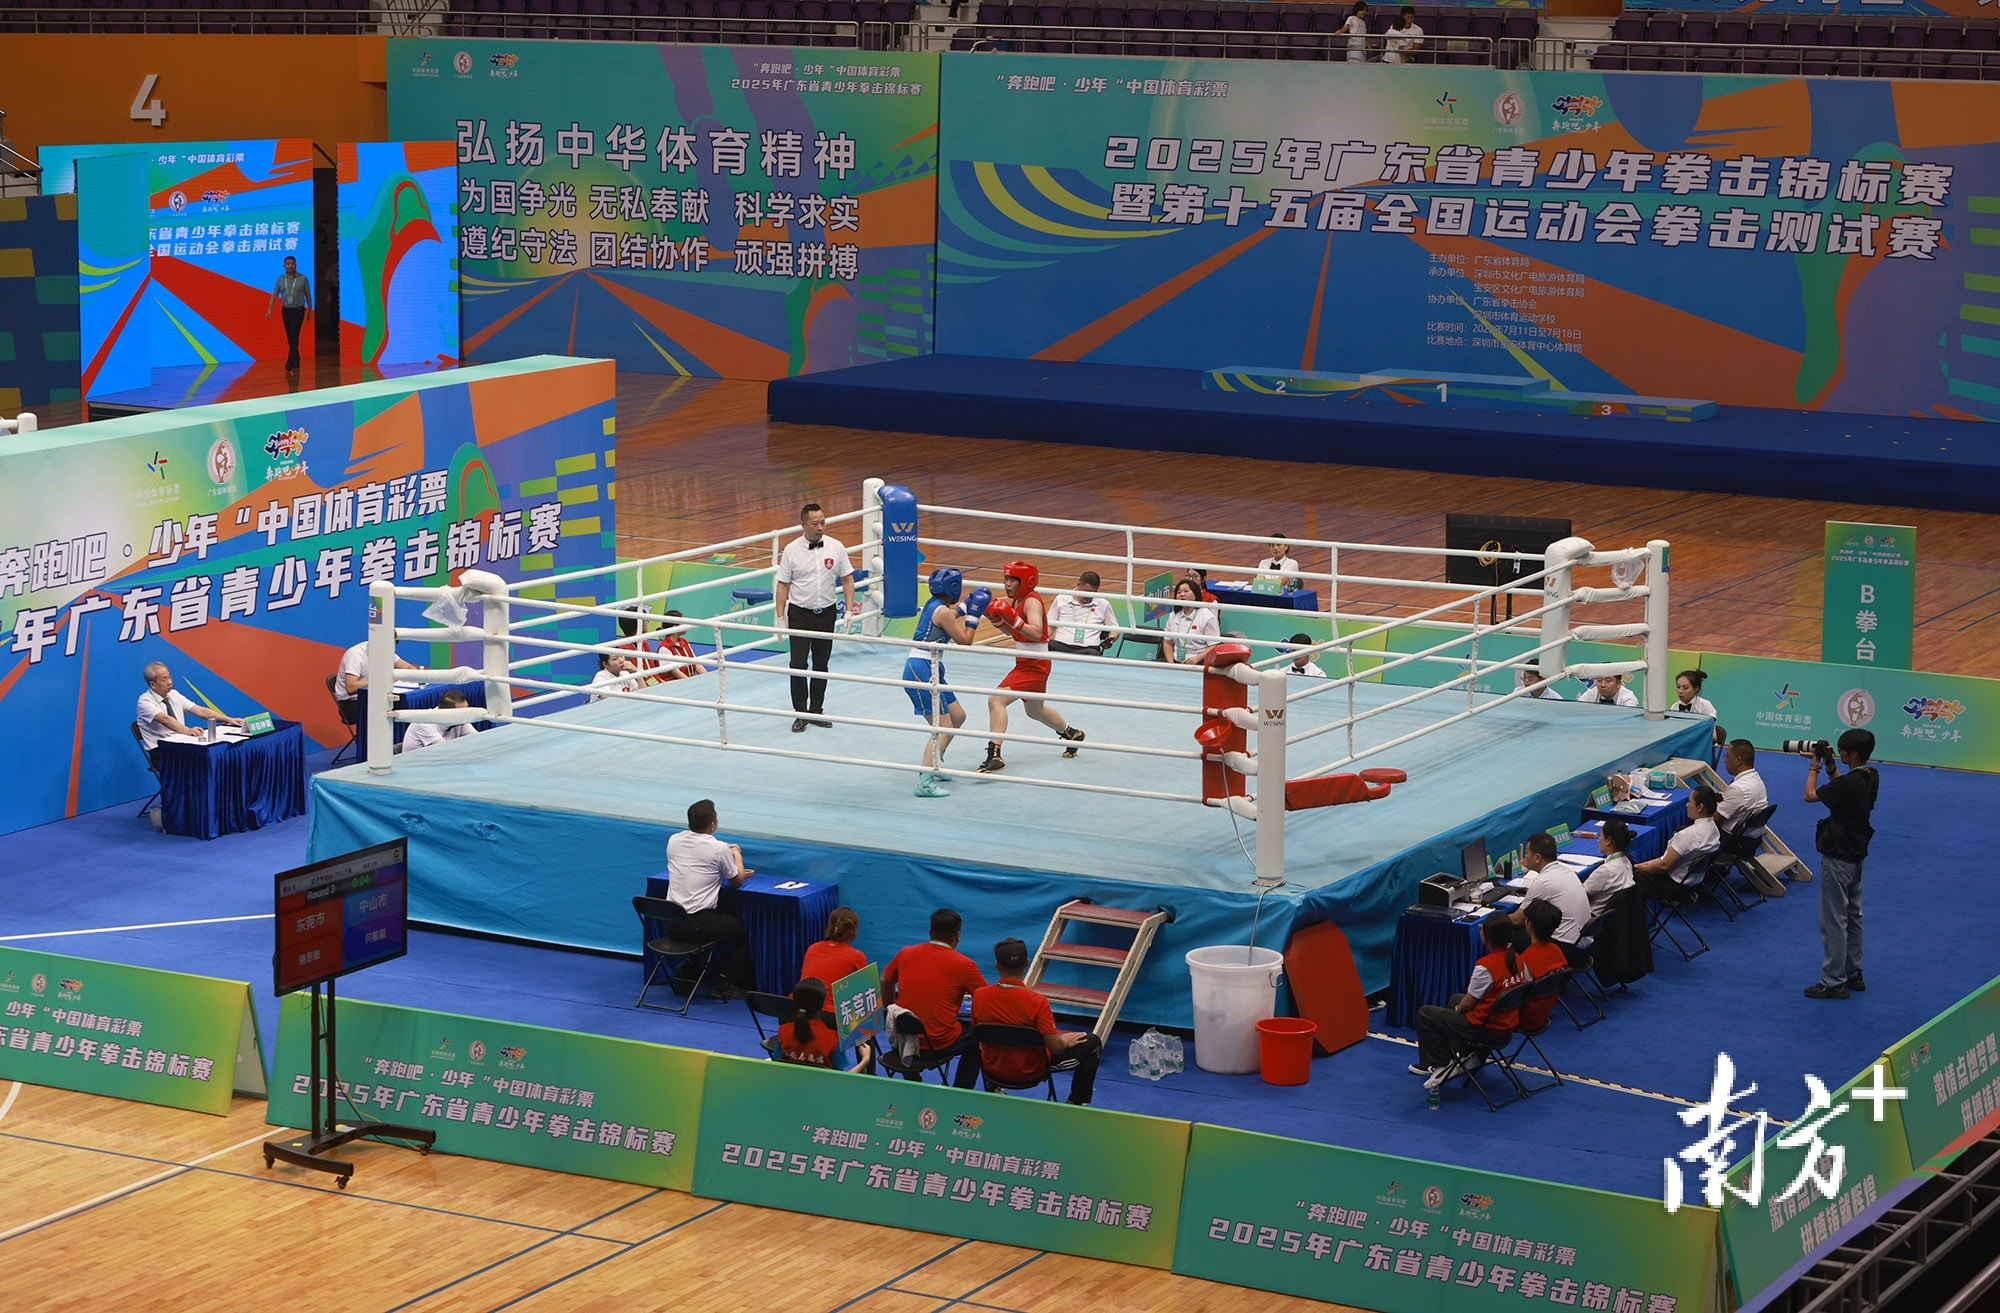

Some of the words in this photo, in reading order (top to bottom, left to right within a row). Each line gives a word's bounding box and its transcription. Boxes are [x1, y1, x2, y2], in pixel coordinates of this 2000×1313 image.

[130, 74, 166, 126] 4
[731, 79, 922, 96] 2025年广东省青少年拳击锦标赛
[455, 119, 858, 180] 弘扬中华体育精神
[1103, 134, 1955, 208] 2025年广东省青少年拳击锦标赛
[461, 178, 577, 218] 为国争光
[589, 183, 709, 226] 无私奉献
[734, 190, 860, 233] 科学求实
[1106, 182, 1945, 261] 暨第十五届全国运动会拳击测试赛
[461, 226, 577, 266] 遵纪守法
[589, 231, 709, 272] 团结协作
[734, 238, 860, 281] 顽强拼搏
[1275, 380, 1286, 393] 2
[1436, 383, 1448, 403] 1
[1601, 404, 1612, 416] 3
[1755, 711, 1812, 725] 中国体育彩票
[307, 886, 331, 901] Round
[360, 894, 388, 914] 中山市
[296, 912, 325, 933] 东莞市
[840, 987, 877, 1026] 东莞市
[721, 1142, 1153, 1232] 2025年广东省青少年拳击锦标赛
